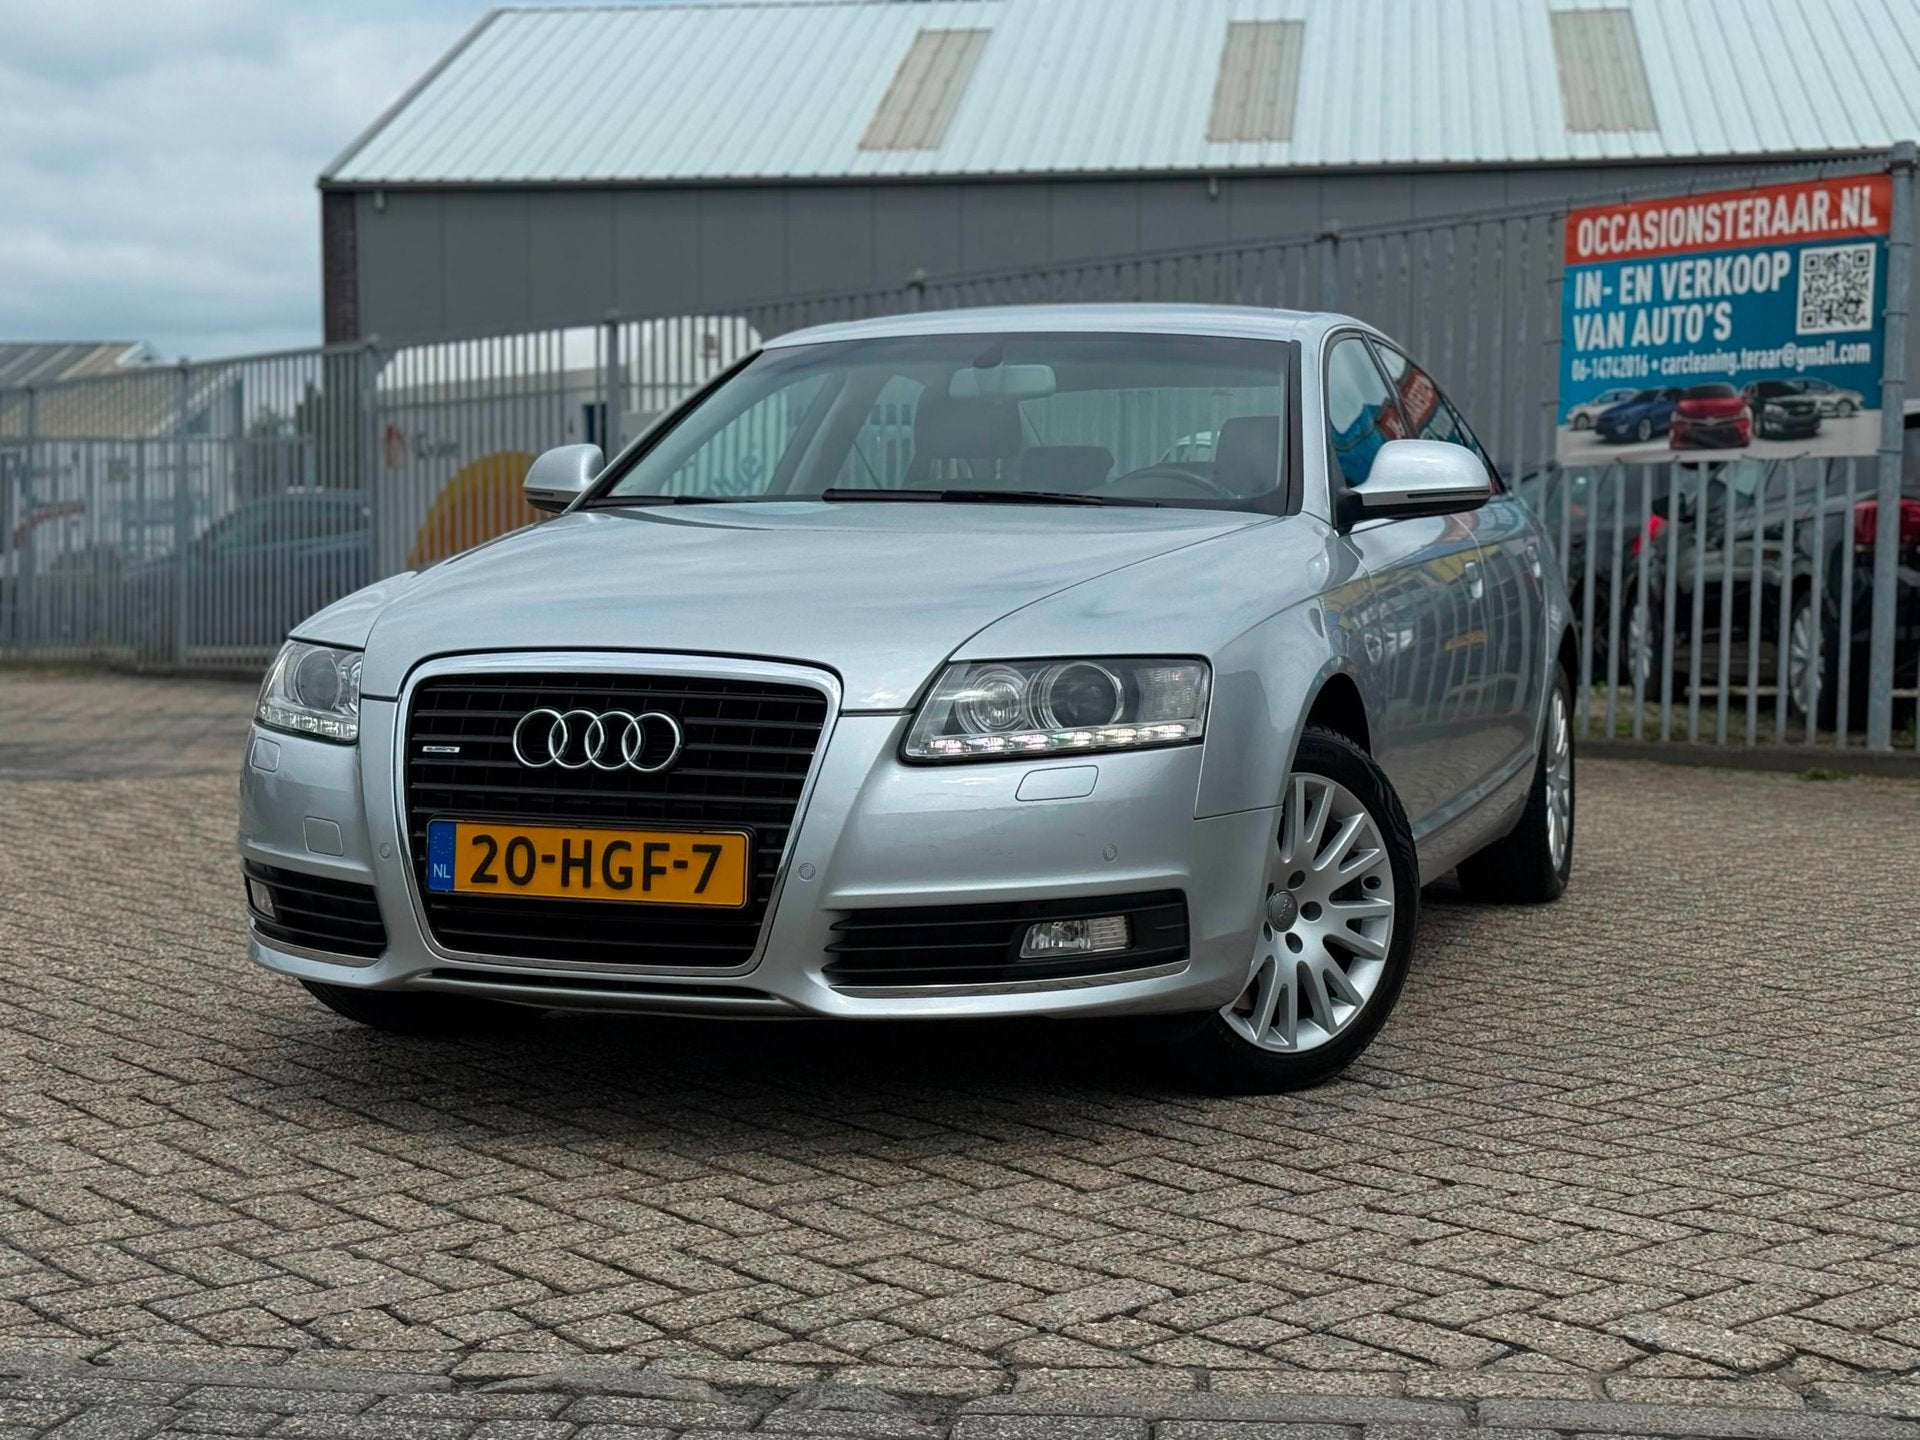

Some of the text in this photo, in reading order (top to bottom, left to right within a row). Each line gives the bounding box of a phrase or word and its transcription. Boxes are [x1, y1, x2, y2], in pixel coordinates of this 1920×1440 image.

[1576, 185, 1878, 257] OCCASIONSTERAAR.NL
[1574, 251, 1792, 309] IN- EN VERKOOP
[1572, 301, 1733, 351] VAN AUTO'S
[1660, 339, 1872, 377] carcleaning.teraar@gmail.com
[433, 863, 451, 879] NL
[470, 834, 723, 894] 20-HGF-7
